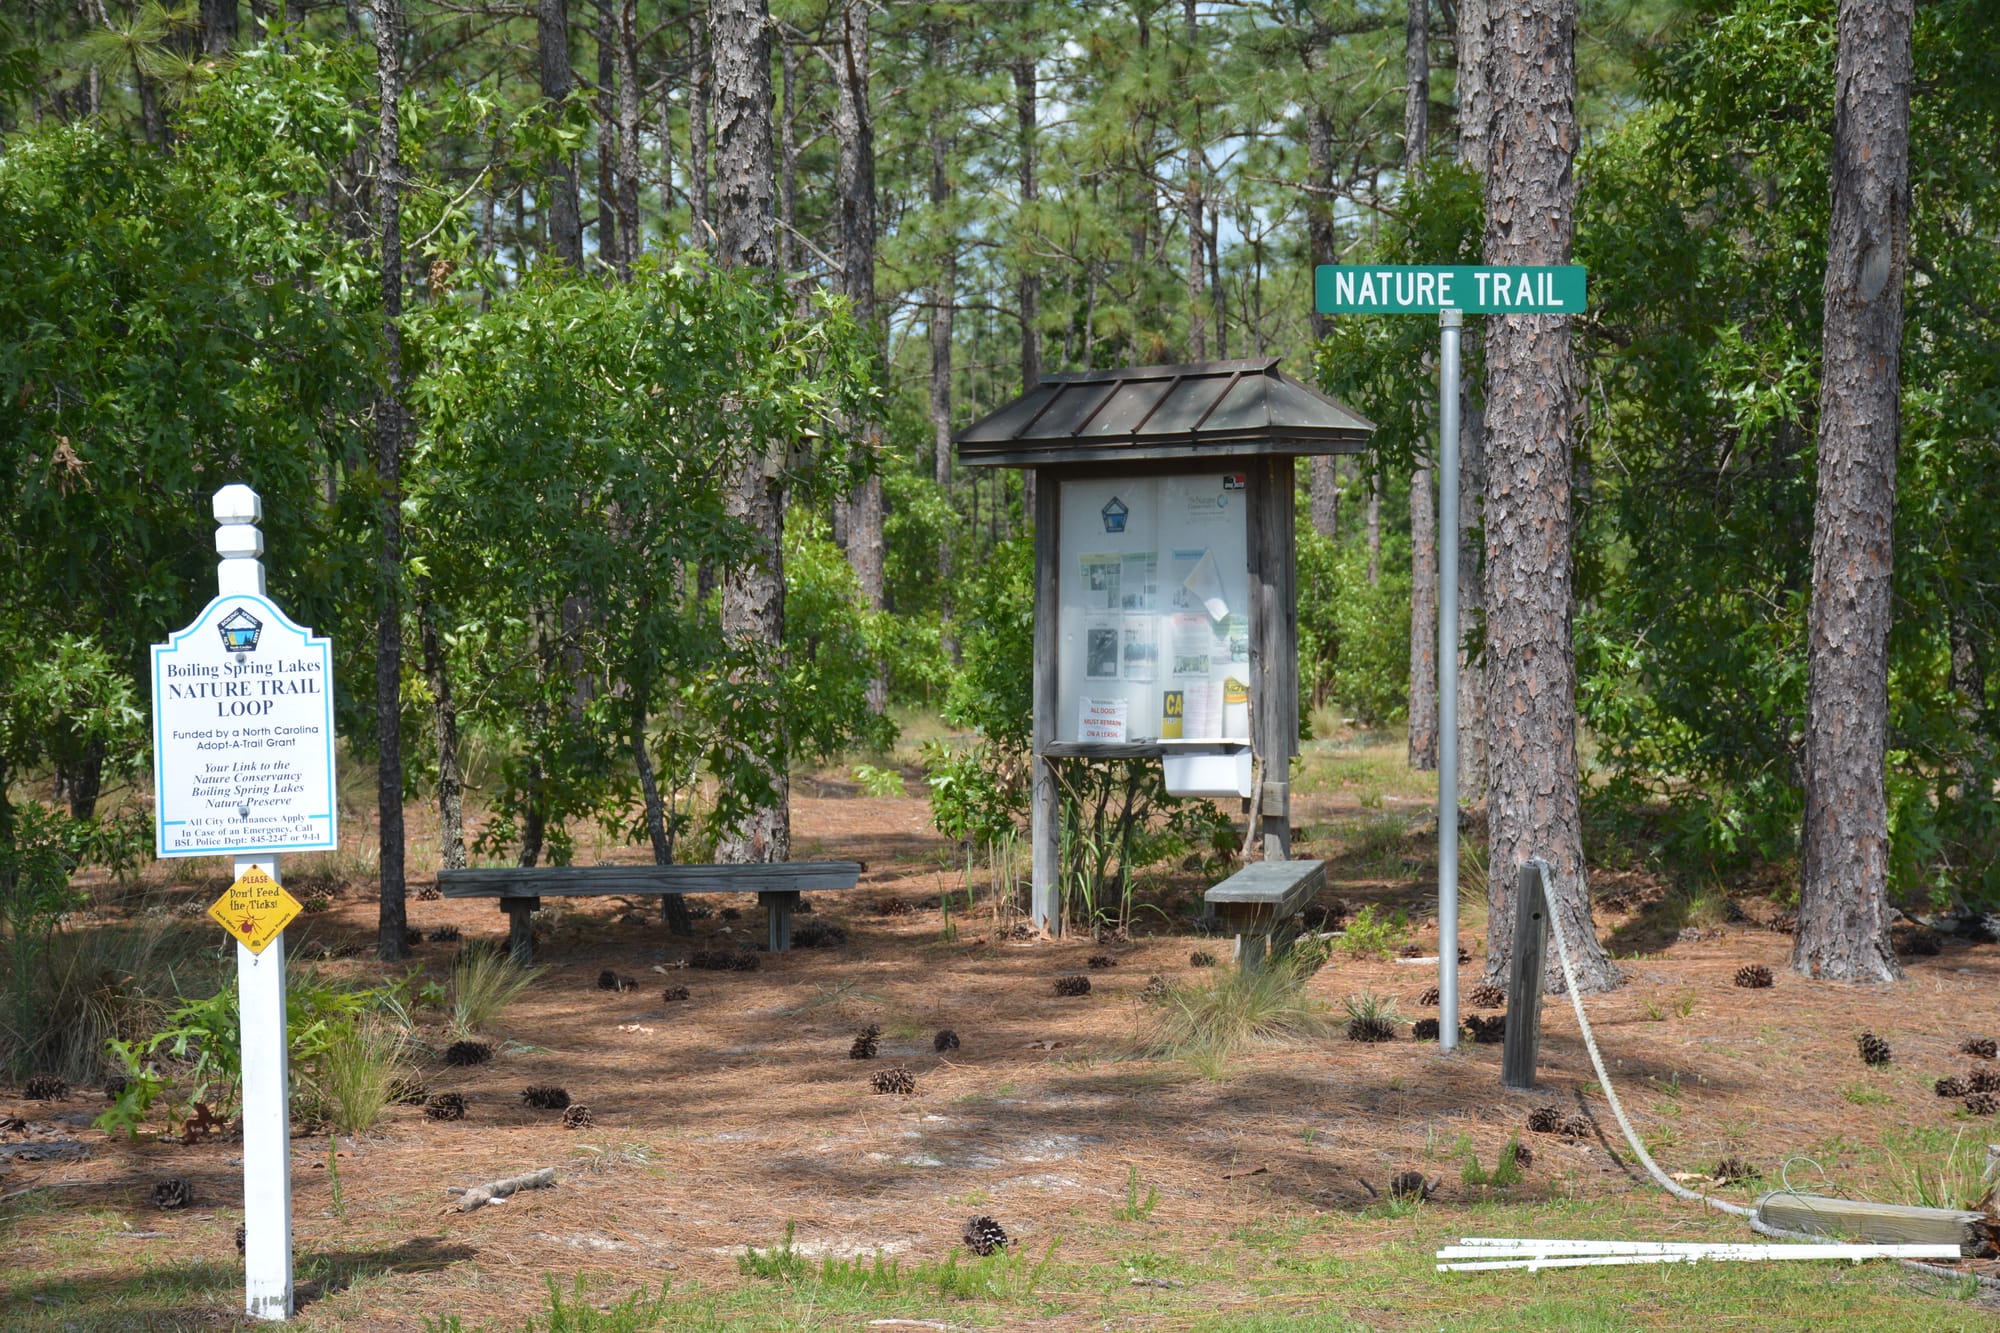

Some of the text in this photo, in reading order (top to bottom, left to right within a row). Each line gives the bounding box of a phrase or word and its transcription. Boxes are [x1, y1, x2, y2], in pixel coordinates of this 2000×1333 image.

[1336, 272, 1564, 306] NATURE TRAIL
[168, 659, 320, 678] Boiling Spring Lakes
[169, 678, 320, 699] NATURE TRAIL
[218, 700, 274, 717] LOOP
[173, 730, 212, 740] Funded
[216, 729, 228, 739] by
[243, 727, 270, 736] North
[274, 726, 318, 735] Carolina
[197, 738, 295, 750] Adopt-A-Trail Grant
[205, 760, 290, 772] Your Link to the
[193, 772, 302, 784] Nature Conservancy
[192, 783, 304, 797] Boiling Spring Lakes
[205, 797, 292, 808] Nature Preserve
[205, 818, 224, 826] City
[228, 816, 277, 825] Ordinances
[282, 814, 305, 823] Apply
[195, 829, 215, 837] Case
[174, 839, 192, 847] BSL
[196, 838, 221, 846] Police
[224, 837, 247, 845] Dept:
[250, 834, 287, 843] 845-2247
[242, 876, 268, 884] PLEASE
[230, 887, 279, 898] Don't Feed
[230, 900, 245, 911] the
[249, 900, 277, 910] Ticks!
